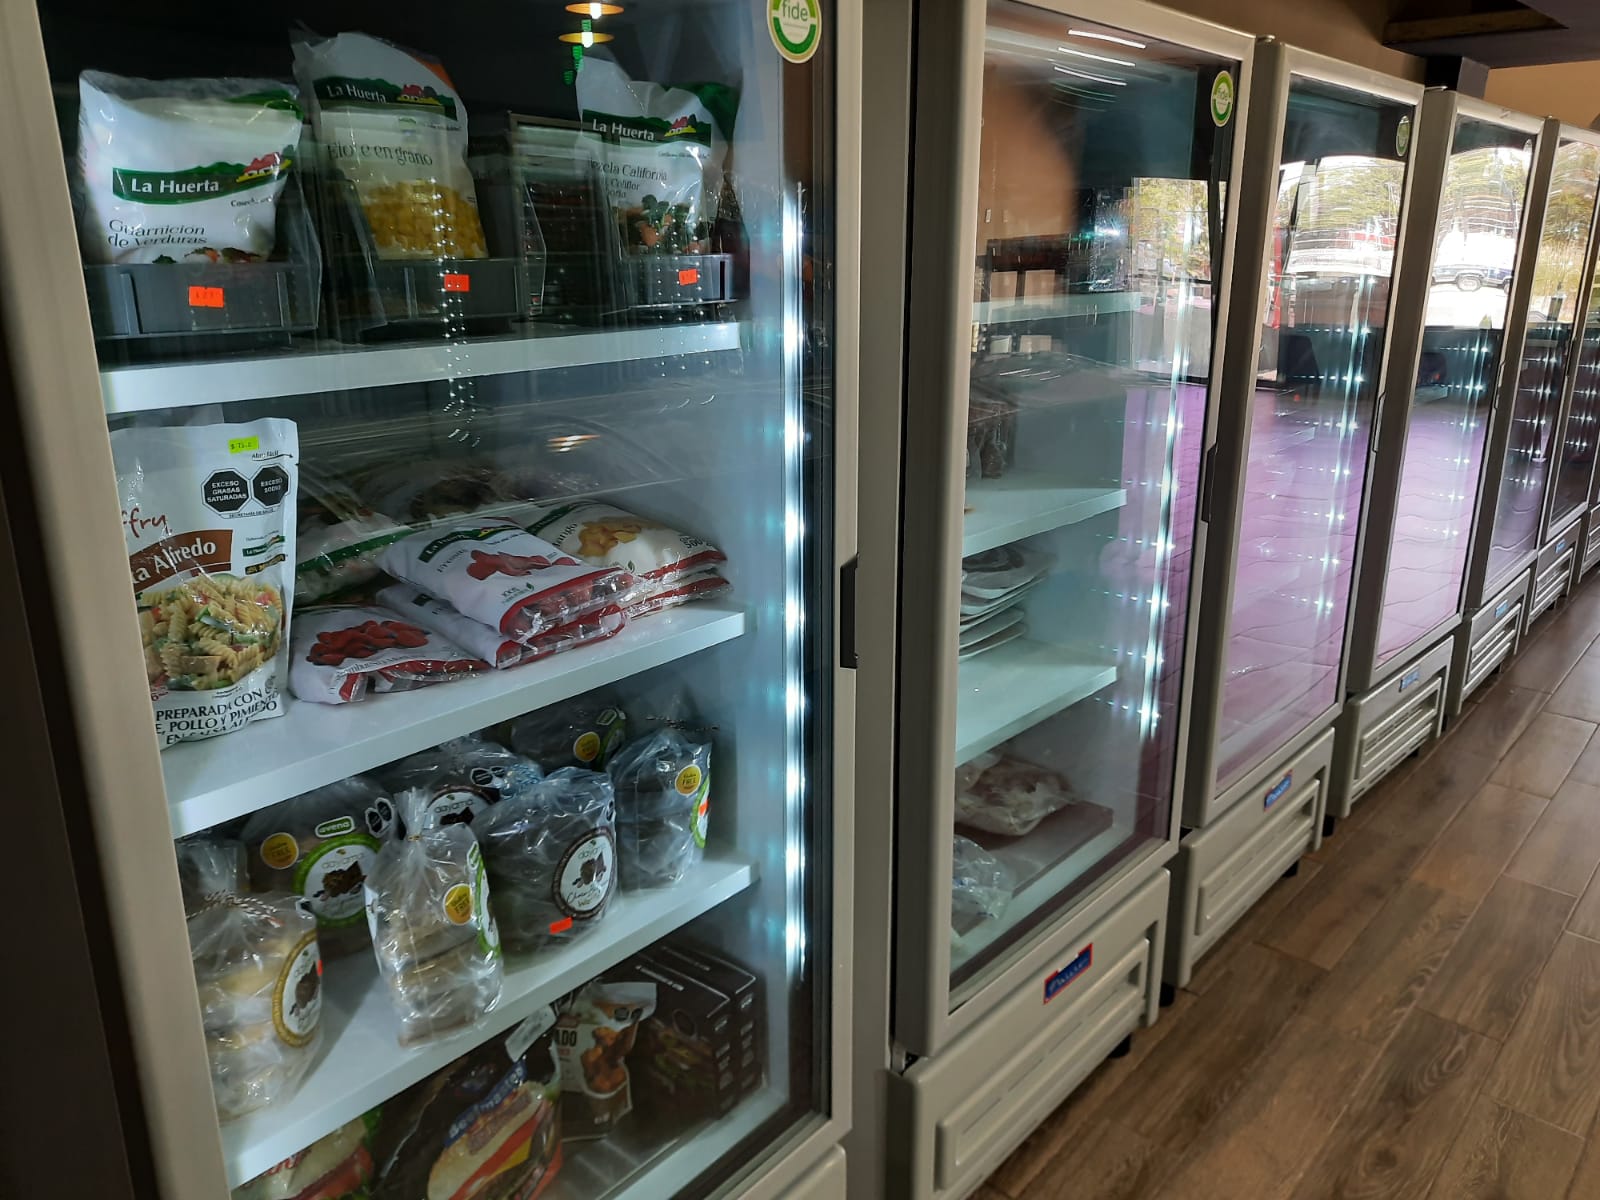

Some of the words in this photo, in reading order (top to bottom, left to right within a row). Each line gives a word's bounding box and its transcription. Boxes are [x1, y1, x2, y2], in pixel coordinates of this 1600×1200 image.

[782, 0, 808, 22] fide
[326, 84, 343, 97] La
[345, 84, 387, 103] Huerta
[592, 119, 607, 133] La
[611, 122, 655, 141] Huerta
[131, 178, 152, 193] La
[159, 178, 219, 194] Huerta
[107, 233, 129, 248] de
[211, 480, 239, 489] EXCESO
[212, 486, 240, 495] GRASAS
[207, 493, 247, 503] SATURADAS
[153, 537, 217, 575] Alfredo
[234, 688, 263, 707] CON
[169, 717, 218, 732] POLLO
